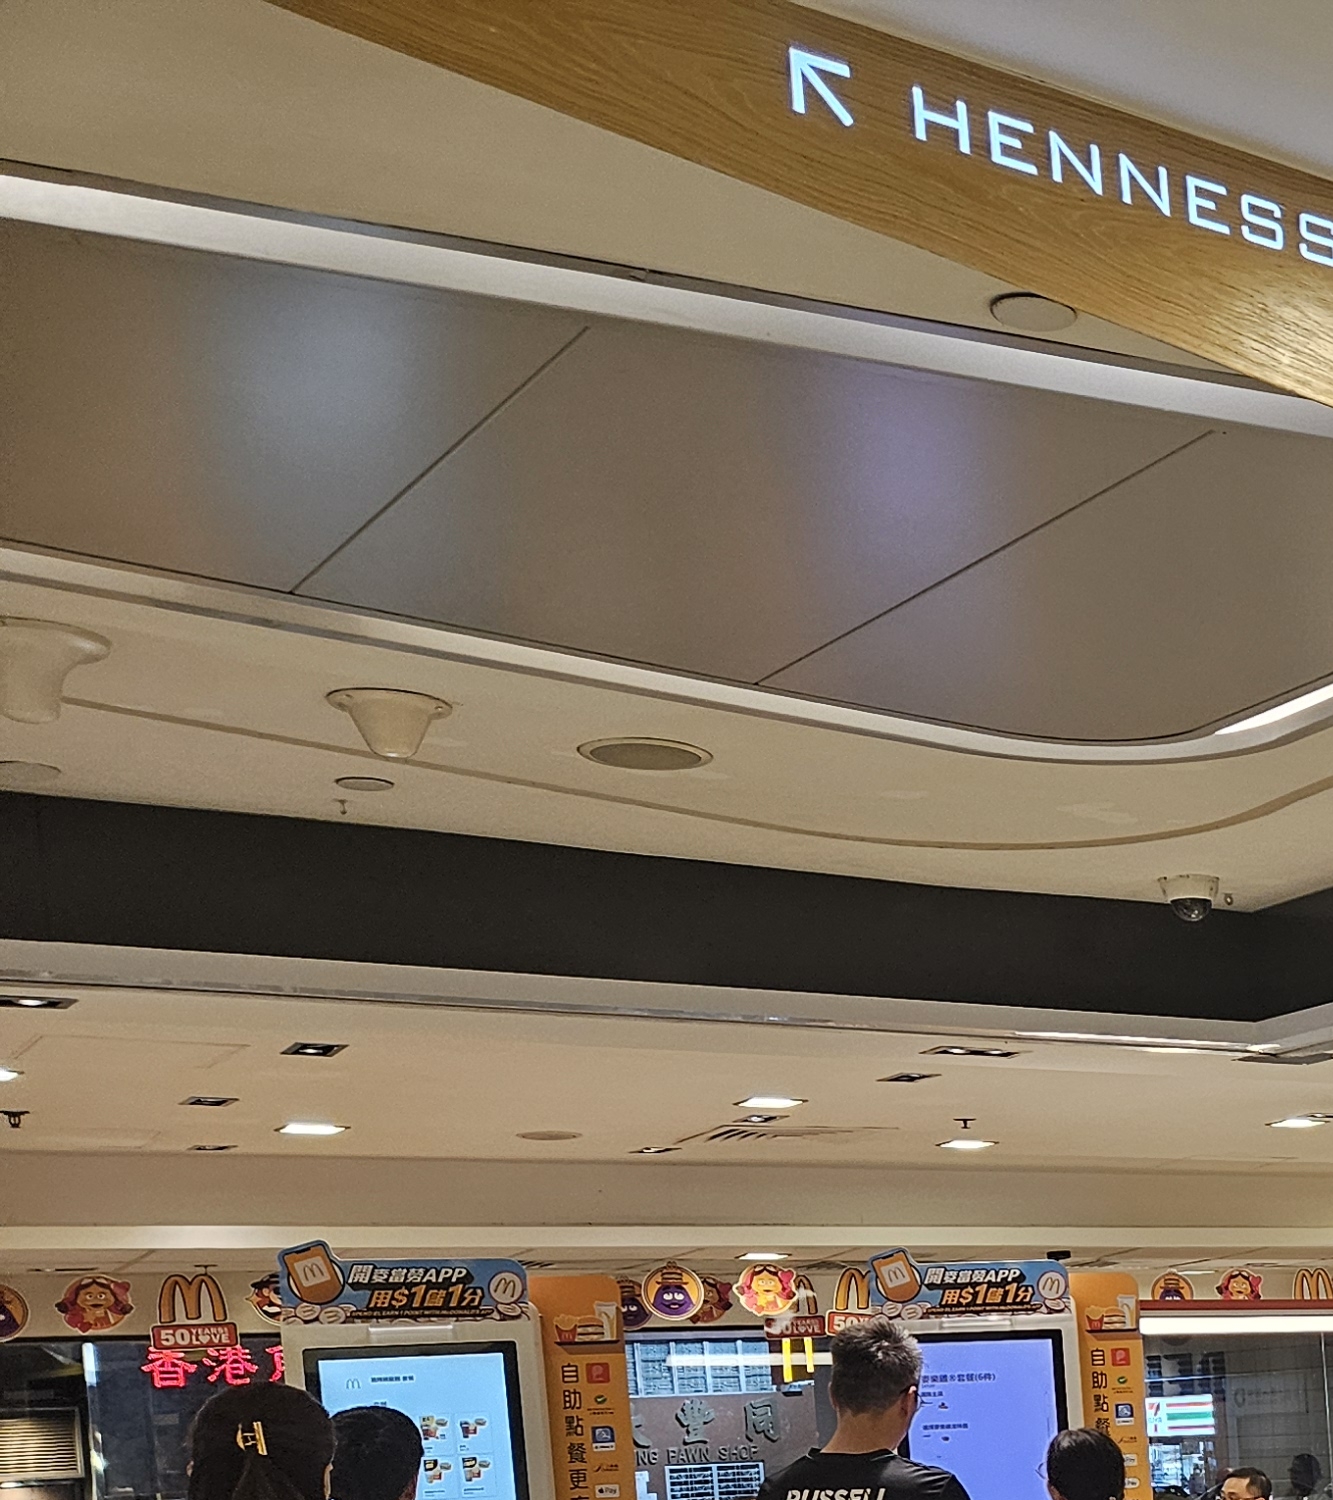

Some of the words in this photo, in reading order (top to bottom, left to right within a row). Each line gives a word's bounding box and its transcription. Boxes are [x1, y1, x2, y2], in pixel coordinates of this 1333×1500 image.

[161, 1329, 190, 1346] 50
[636, 1449, 658, 1466] NG
[667, 1447, 710, 1464] PAWN
[718, 1445, 759, 1461] SHOP
